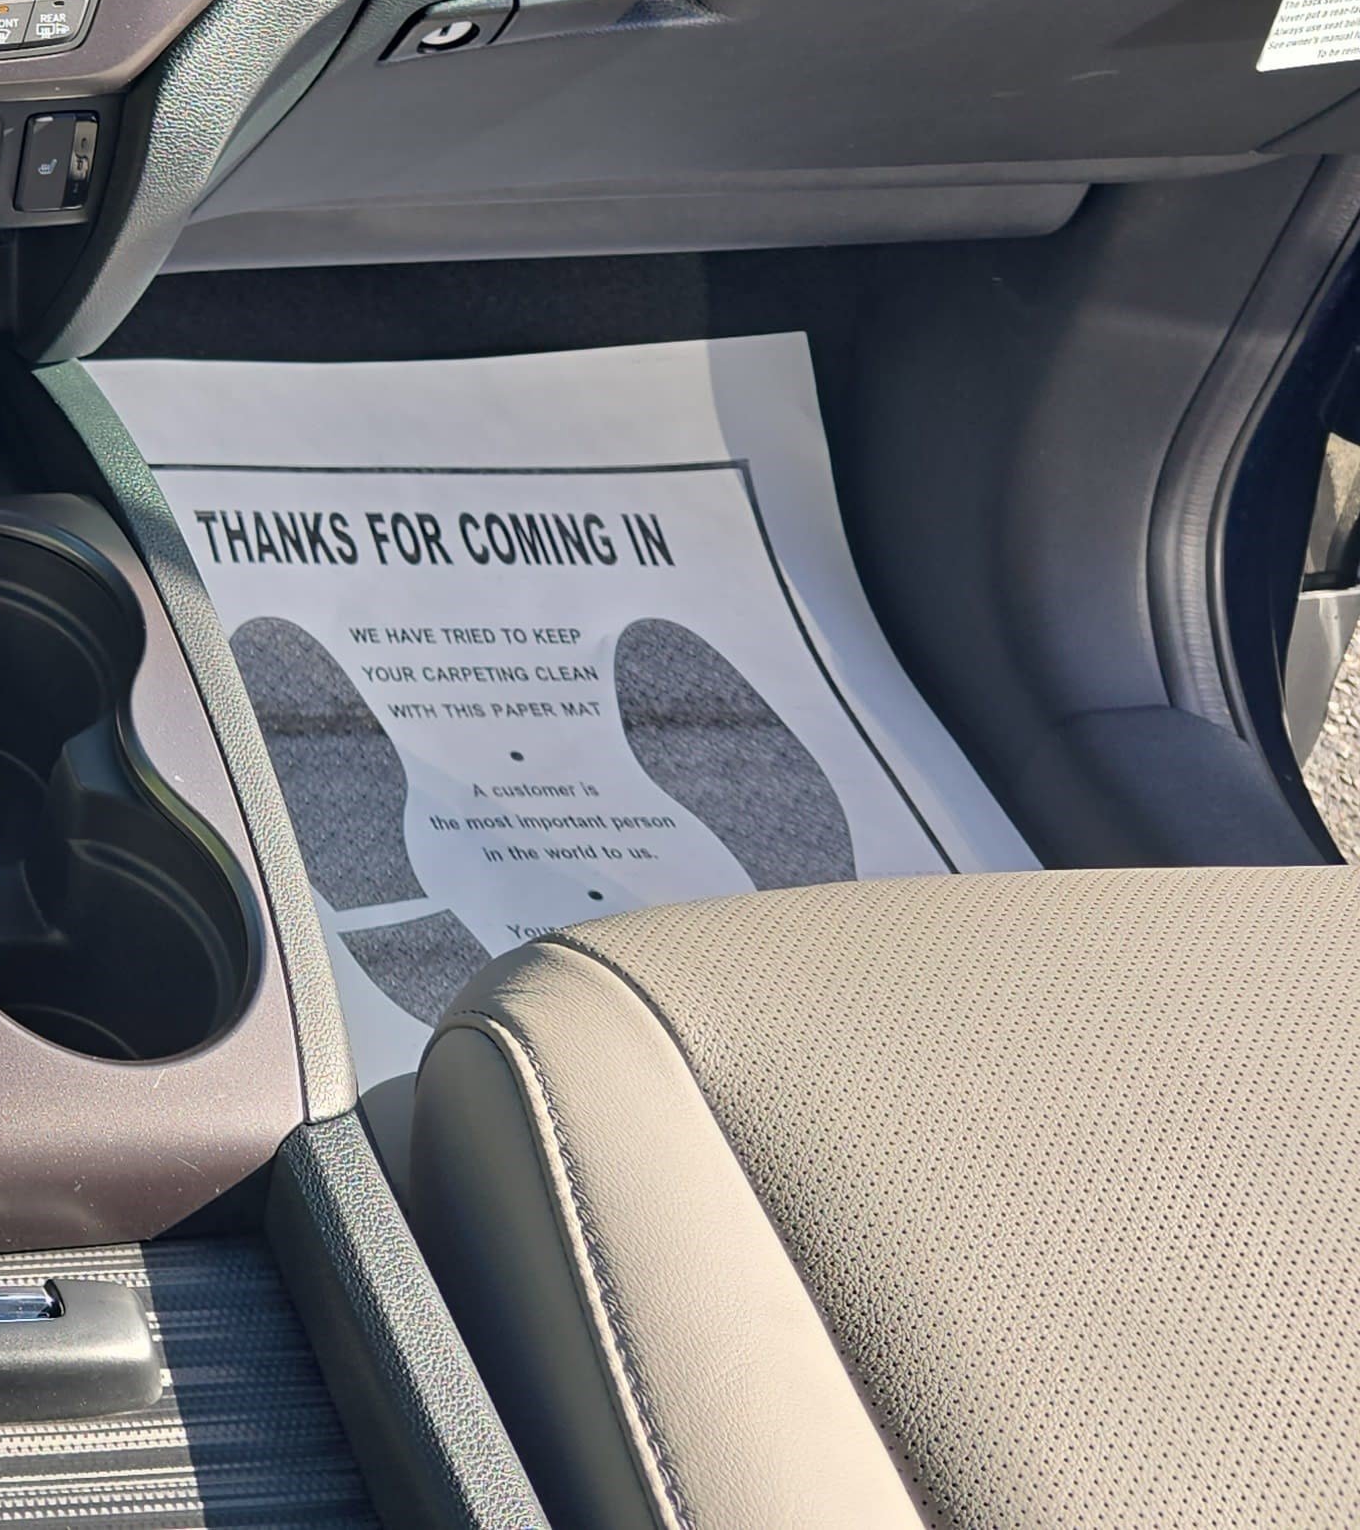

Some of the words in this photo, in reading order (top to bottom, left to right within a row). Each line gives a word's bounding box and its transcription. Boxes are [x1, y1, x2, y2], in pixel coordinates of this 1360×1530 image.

[40, 13, 67, 23] REAR
[193, 509, 359, 568] THANKS
[365, 511, 454, 567] FOR
[458, 511, 619, 568] COMING
[621, 513, 677, 568] IN
[348, 627, 380, 645] WE
[385, 627, 437, 645] HAVE
[441, 627, 497, 645] TRIED
[500, 627, 527, 645] TO
[532, 627, 582, 645] KEEP
[361, 665, 417, 683] YOUR
[421, 665, 529, 683] CARPETING
[535, 665, 600, 683] CLEAN
[388, 703, 436, 719] WITH
[441, 702, 486, 719] THIS
[491, 701, 557, 719] PAPER
[560, 700, 602, 718] MAT
[472, 783, 488, 798] A
[491, 782, 577, 798] customer
[581, 781, 600, 797] is
[430, 815, 460, 831] the
[465, 814, 514, 830] most
[516, 813, 607, 835] important
[611, 815, 677, 832] person
[482, 846, 504, 863] in
[507, 845, 540, 861] the
[543, 844, 598, 861] world
[601, 845, 623, 860] to
[628, 846, 659, 860] us.
